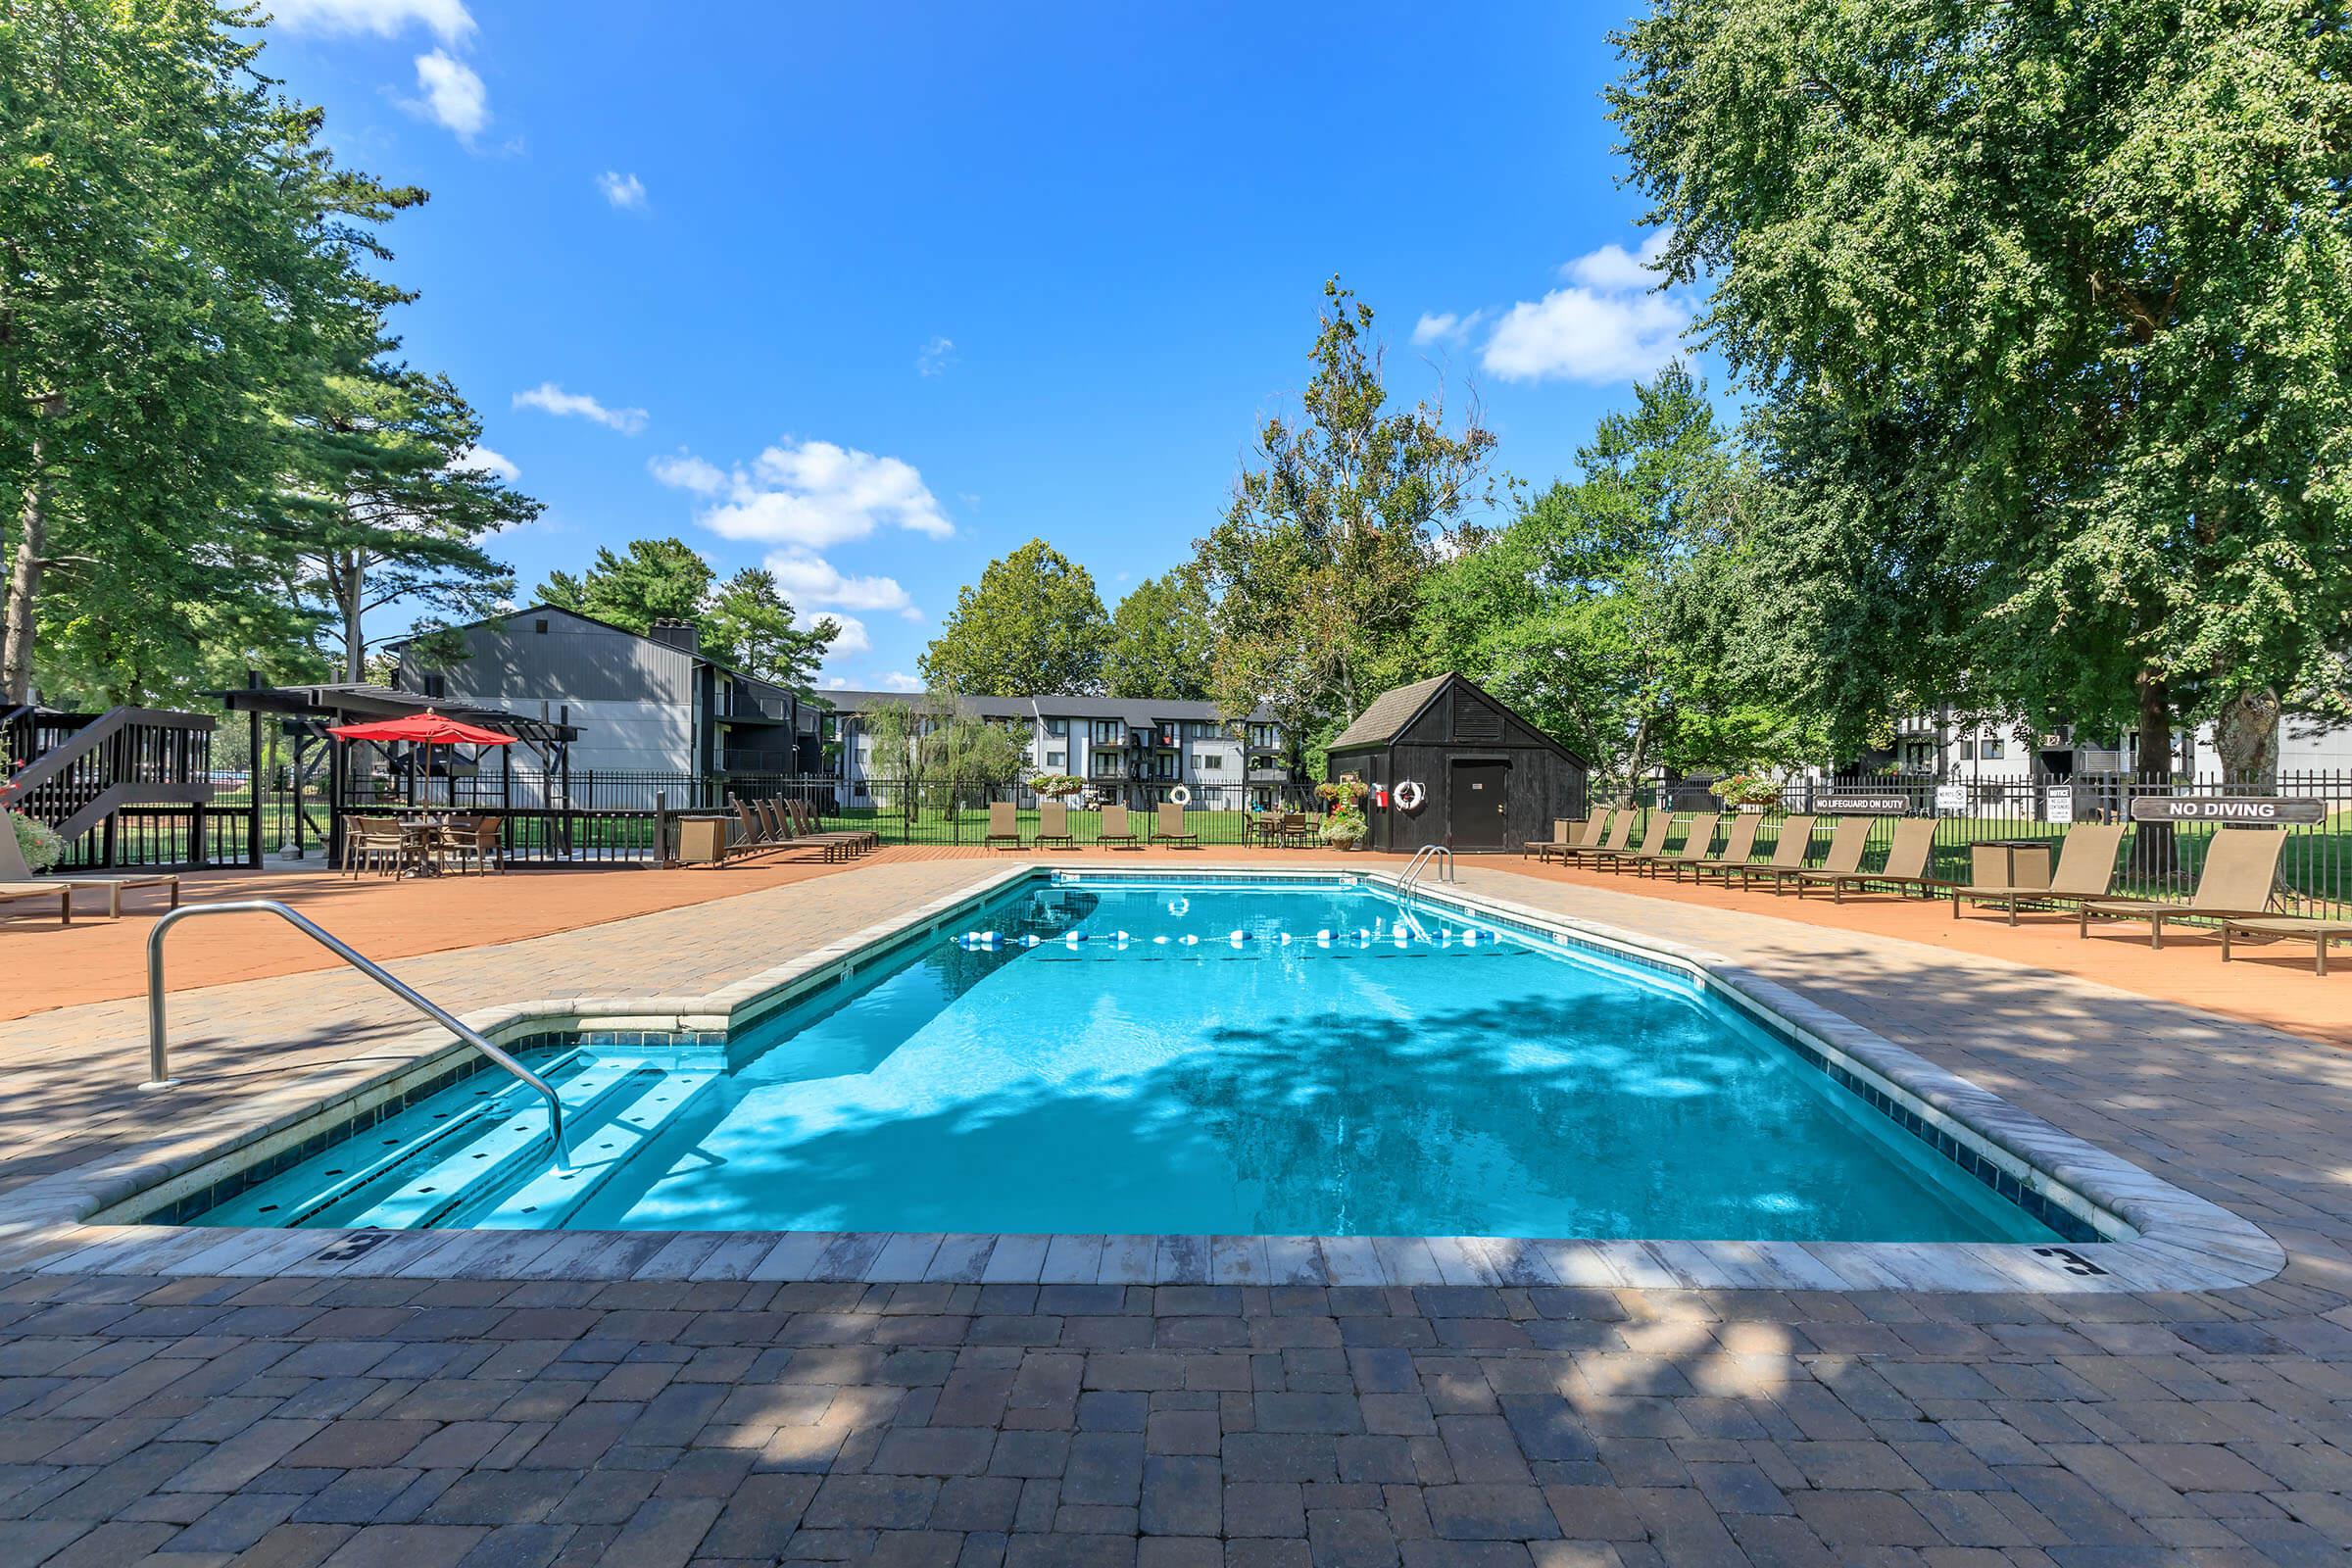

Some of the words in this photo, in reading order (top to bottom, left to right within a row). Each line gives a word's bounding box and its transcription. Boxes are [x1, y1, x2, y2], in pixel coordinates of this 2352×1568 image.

[1829, 800, 1868, 808] LIFEGUARD
[1882, 800, 1903, 808] DUTY
[2170, 803, 2197, 815] NO
[2205, 803, 2275, 817] DIVING
[318, 1234, 392, 1260] 3
[2033, 1248, 2109, 1276] 3
